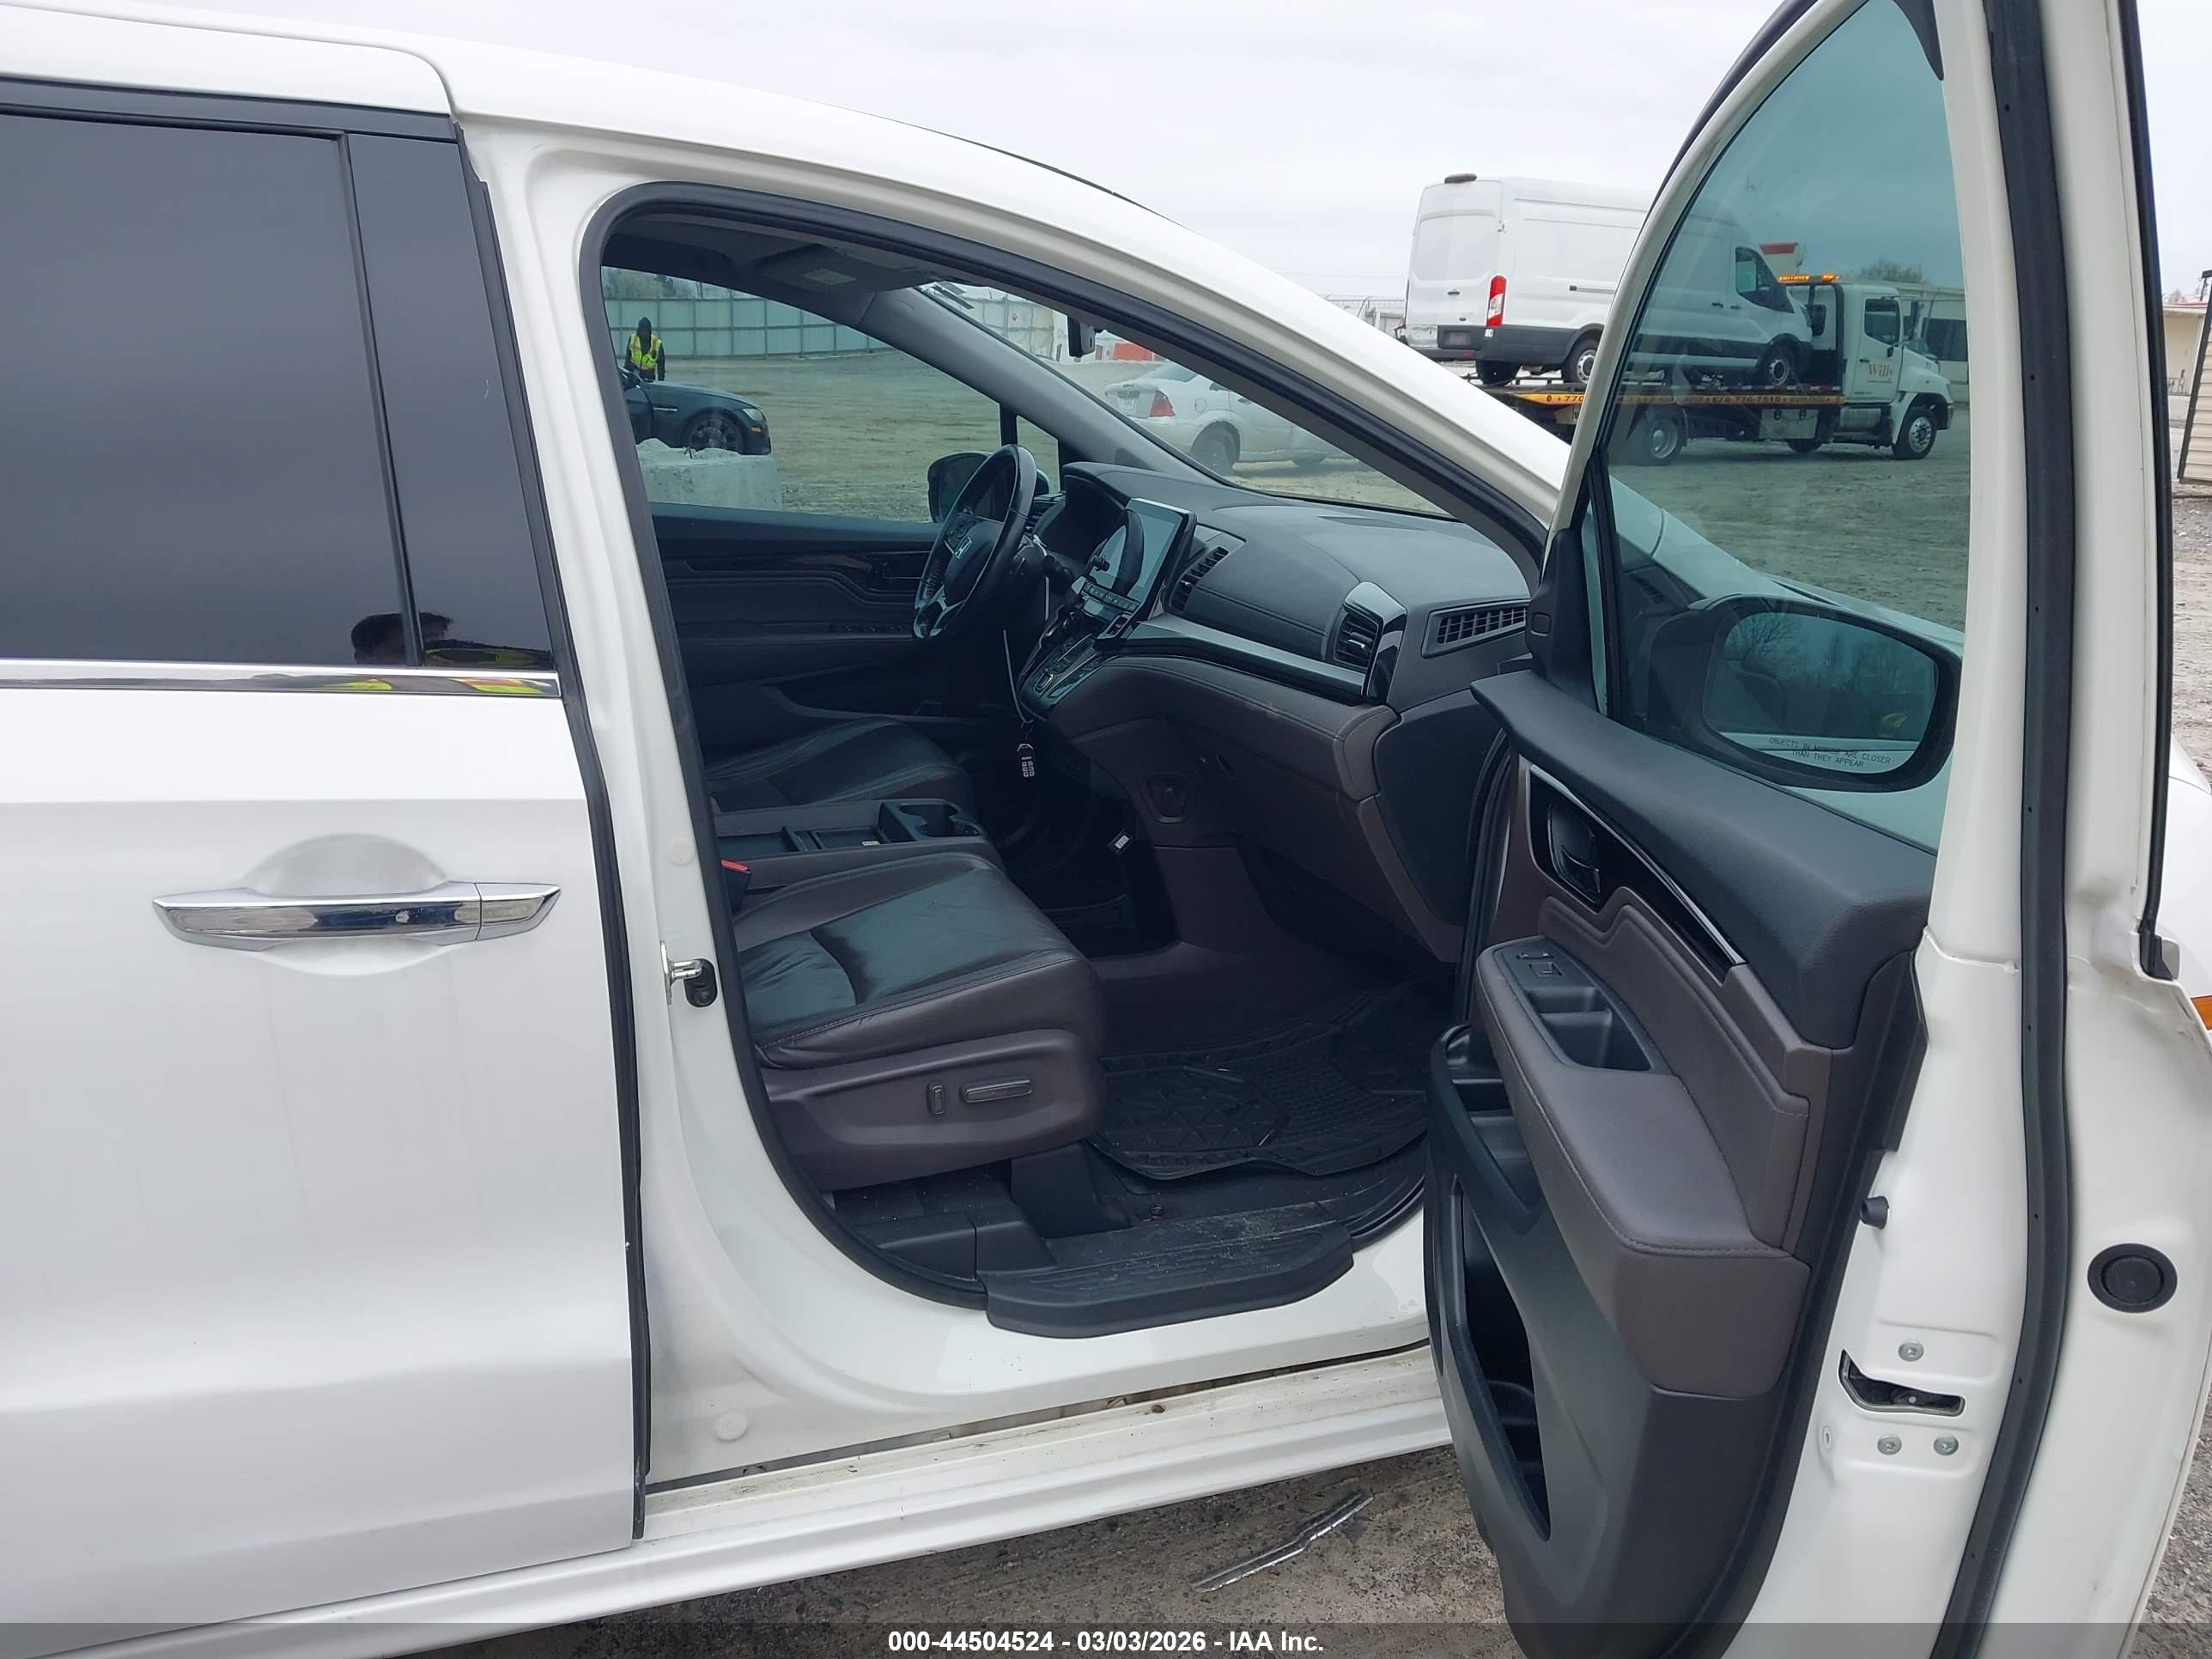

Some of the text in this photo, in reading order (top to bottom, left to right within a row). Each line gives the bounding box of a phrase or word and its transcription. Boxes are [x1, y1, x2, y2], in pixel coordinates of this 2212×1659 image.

[1769, 737, 1799, 748] OBJECTS
[1814, 744, 1841, 756] MIRROR
[1844, 750, 1859, 759] ARE
[1862, 752, 1891, 764] CLOSER
[1792, 750, 1864, 768] THAN THEY APPEAR
